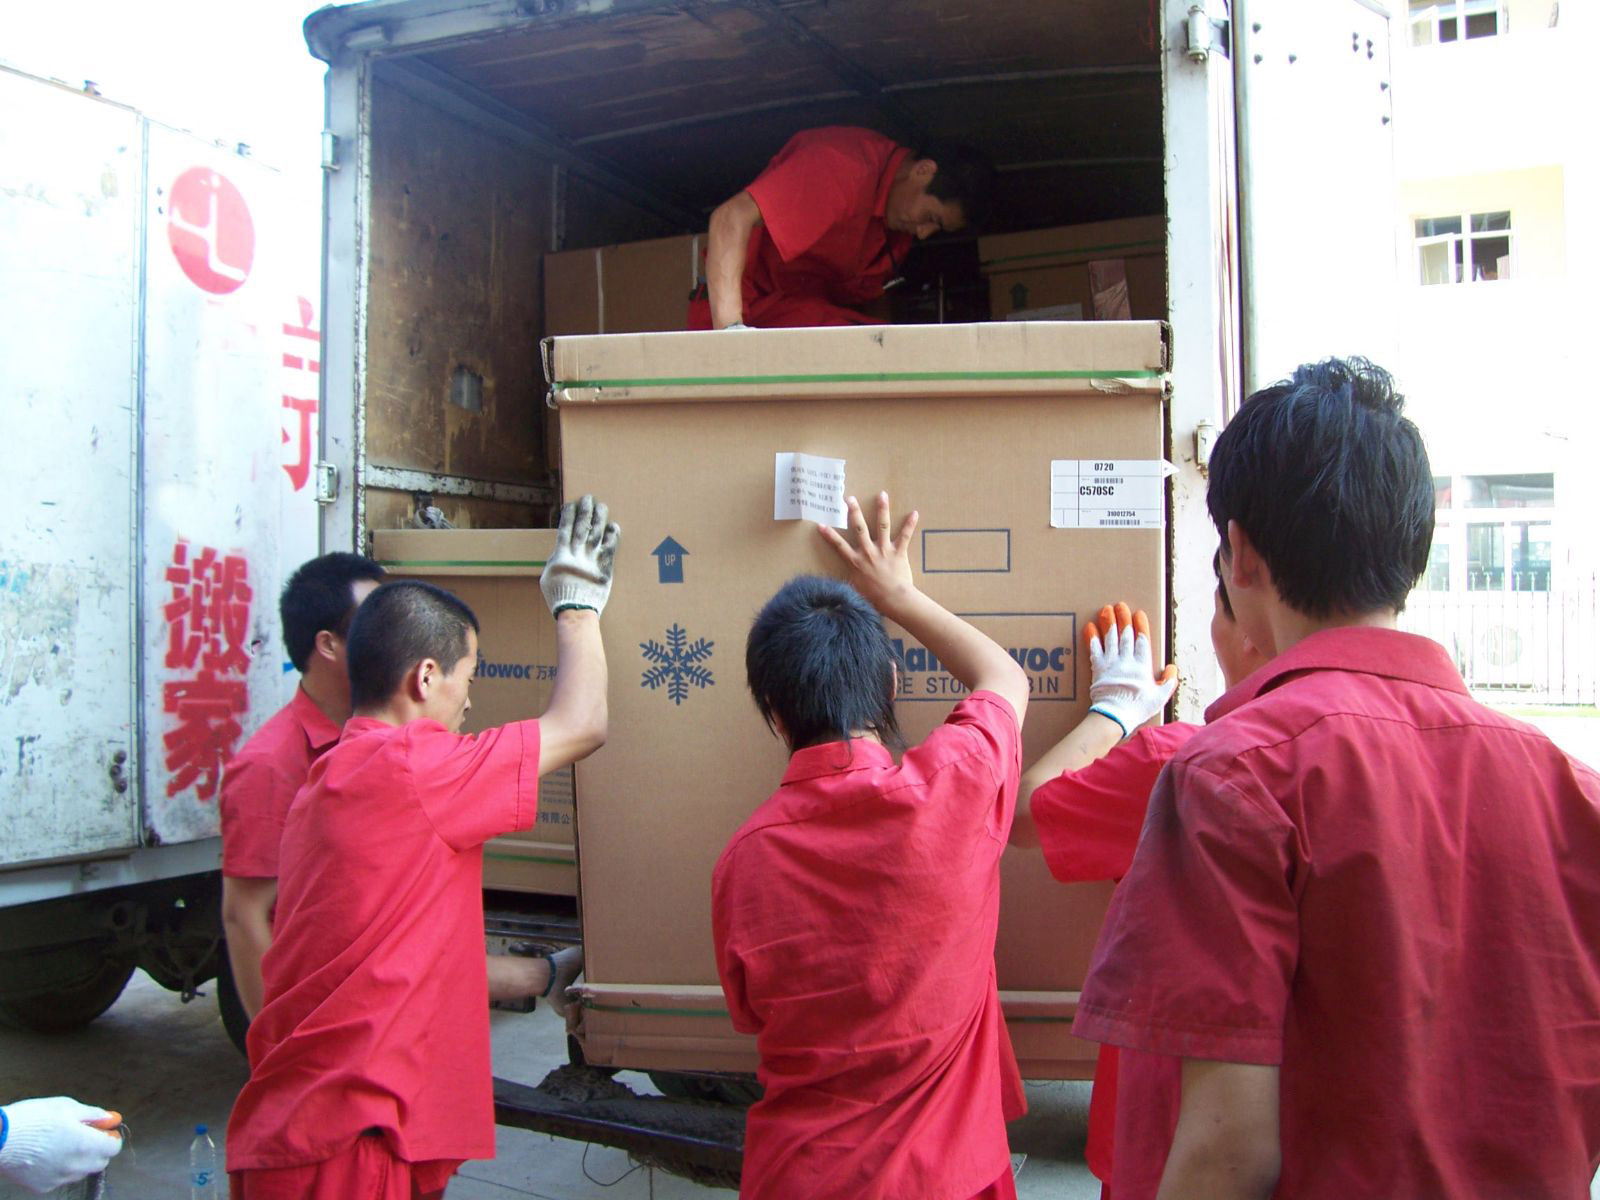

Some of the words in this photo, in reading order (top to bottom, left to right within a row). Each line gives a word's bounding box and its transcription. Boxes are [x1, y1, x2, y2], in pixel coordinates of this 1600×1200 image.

[1094, 462, 1114, 471] 0720
[1079, 485, 1115, 496] C570SC
[664, 553, 676, 567] UP
